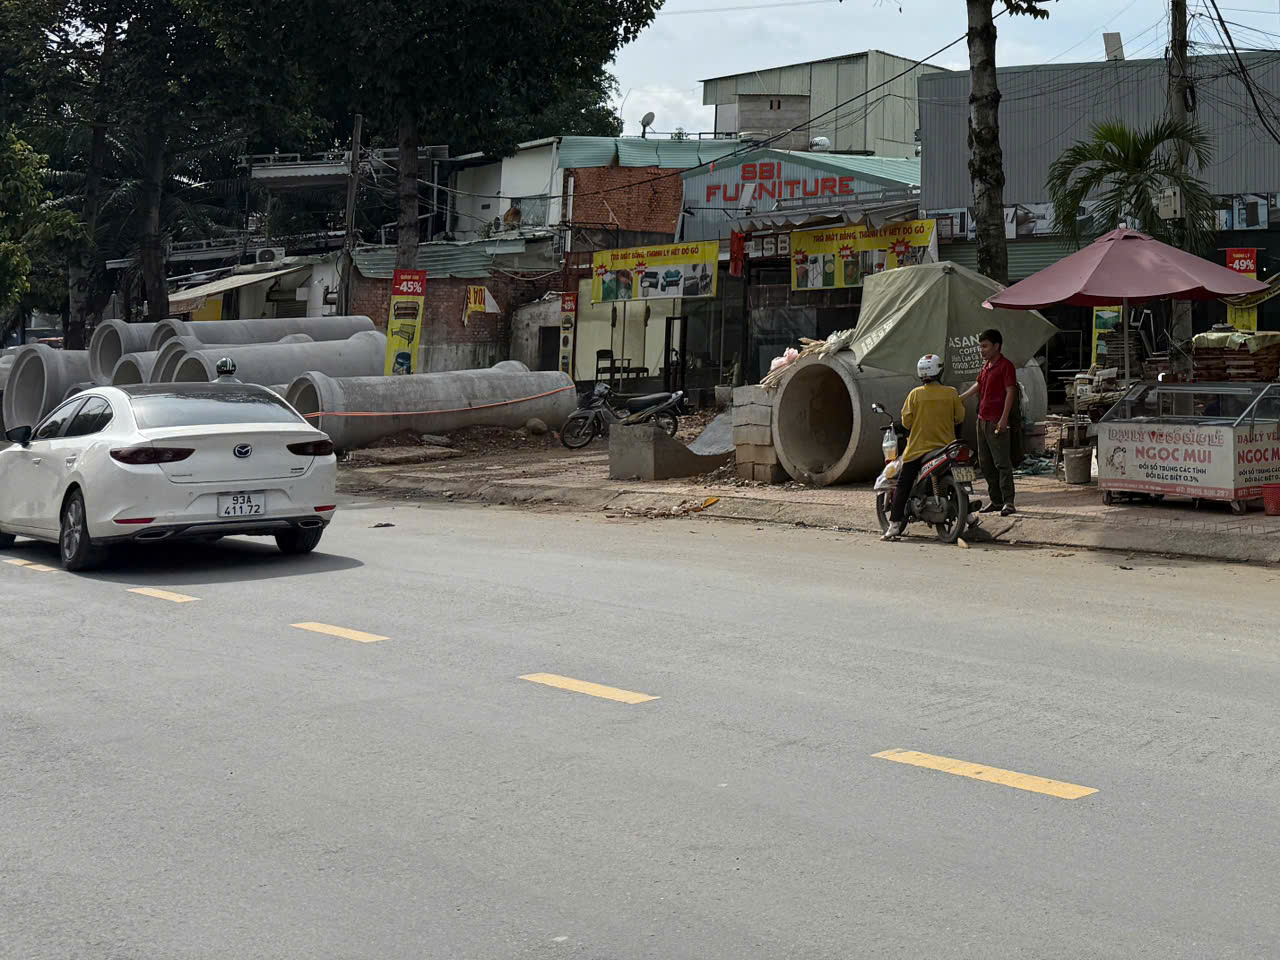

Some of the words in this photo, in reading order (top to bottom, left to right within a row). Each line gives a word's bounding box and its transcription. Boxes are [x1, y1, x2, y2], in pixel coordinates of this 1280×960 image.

[741, 162, 781, 180] SBI
[1229, 259, 1254, 270] -49%
[395, 281, 422, 293] -45%
[949, 333, 982, 348] ASAN
[1135, 446, 1180, 462] NGỌC
[1237, 448, 1269, 464] NGỌC
[232, 495, 252, 505] 93A
[224, 504, 261, 515] 411.72
